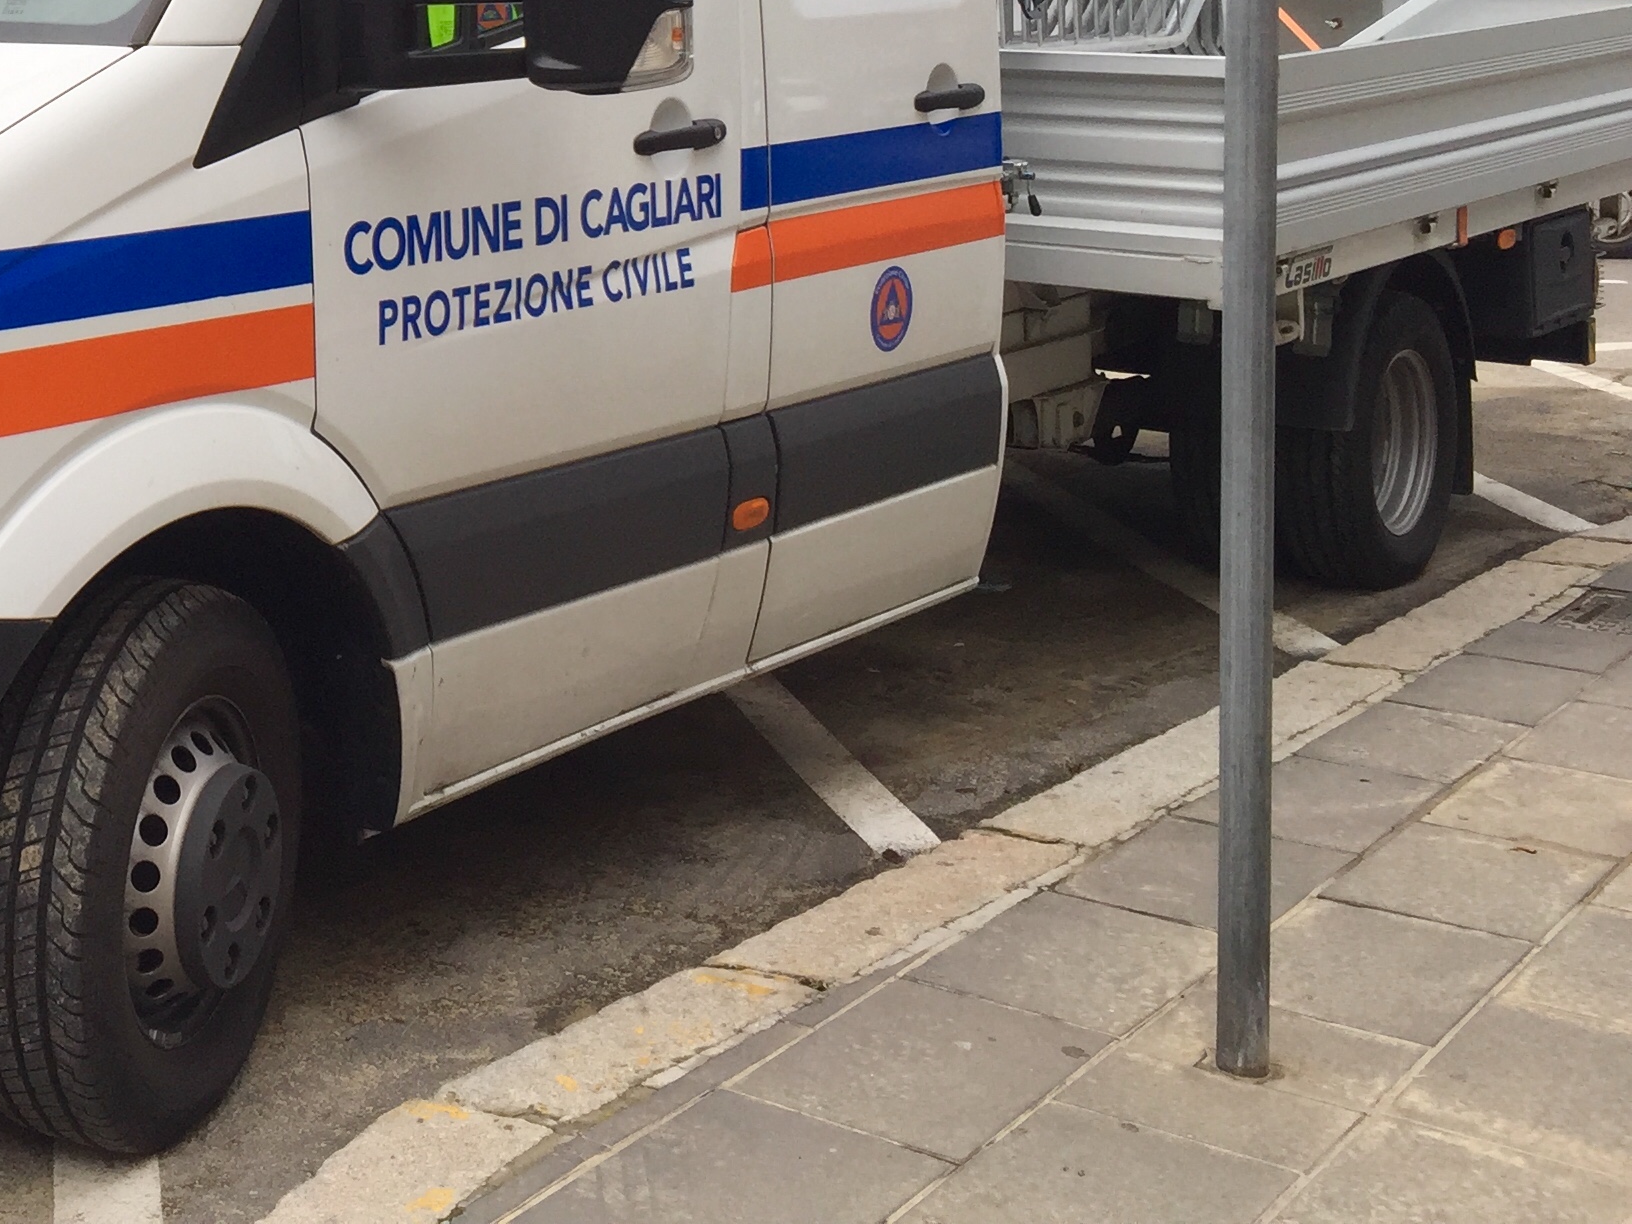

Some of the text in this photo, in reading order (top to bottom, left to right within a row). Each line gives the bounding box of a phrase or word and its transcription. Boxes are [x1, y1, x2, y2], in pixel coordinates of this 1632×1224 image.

[344, 173, 722, 276] COMUNE DI CAGLIARI
[378, 247, 695, 346] PROTEZIONE CIVILE
